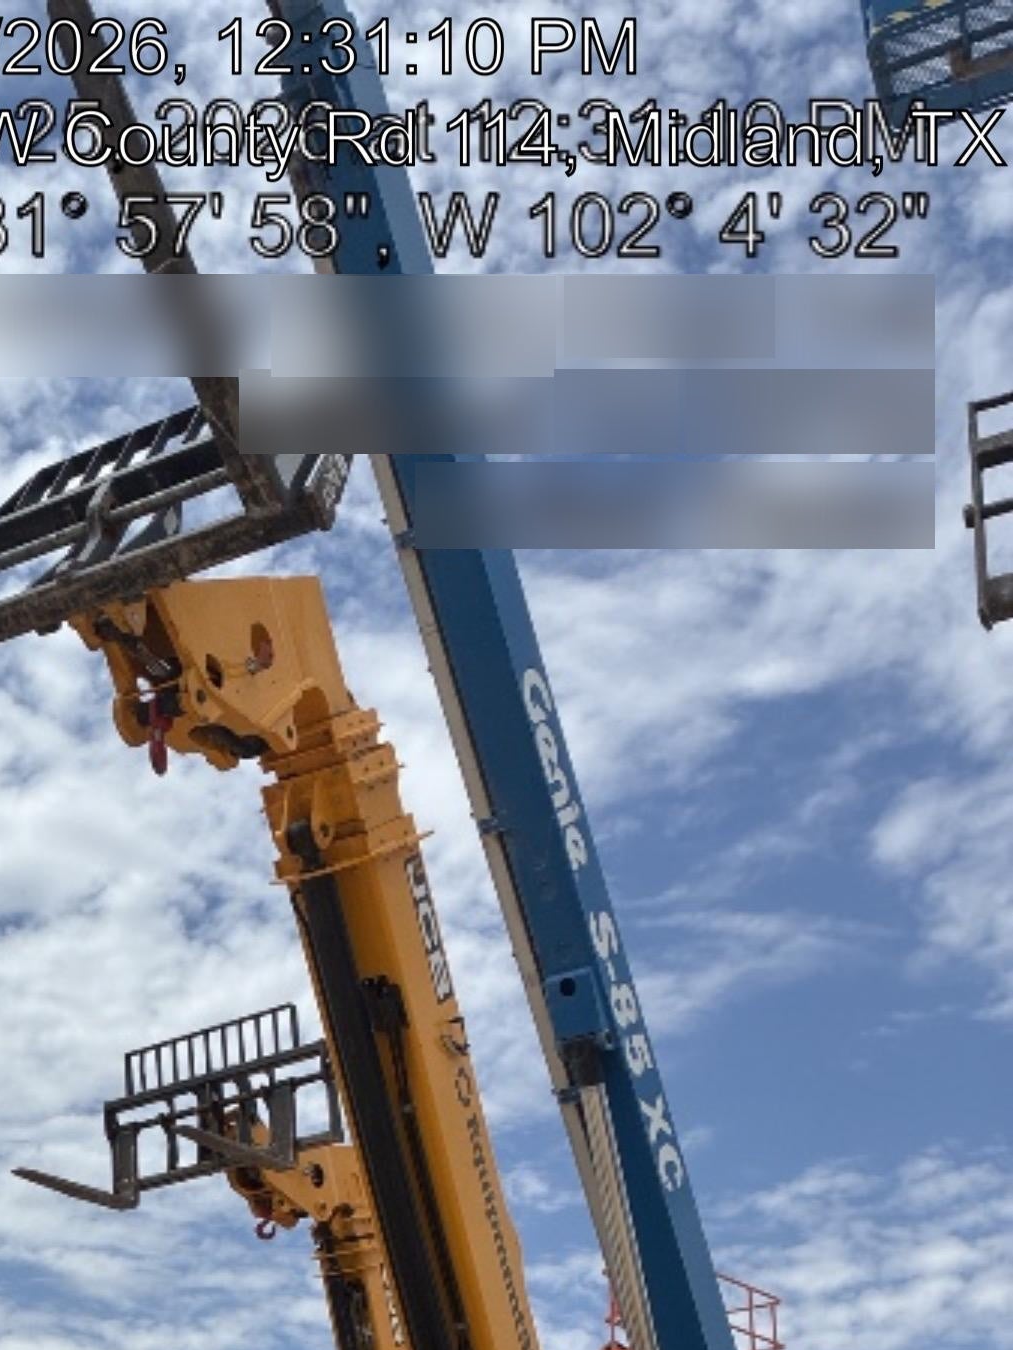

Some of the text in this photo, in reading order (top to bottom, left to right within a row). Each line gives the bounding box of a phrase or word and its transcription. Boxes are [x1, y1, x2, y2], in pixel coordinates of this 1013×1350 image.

[523, 667, 684, 1192] Genie S-85 XC
